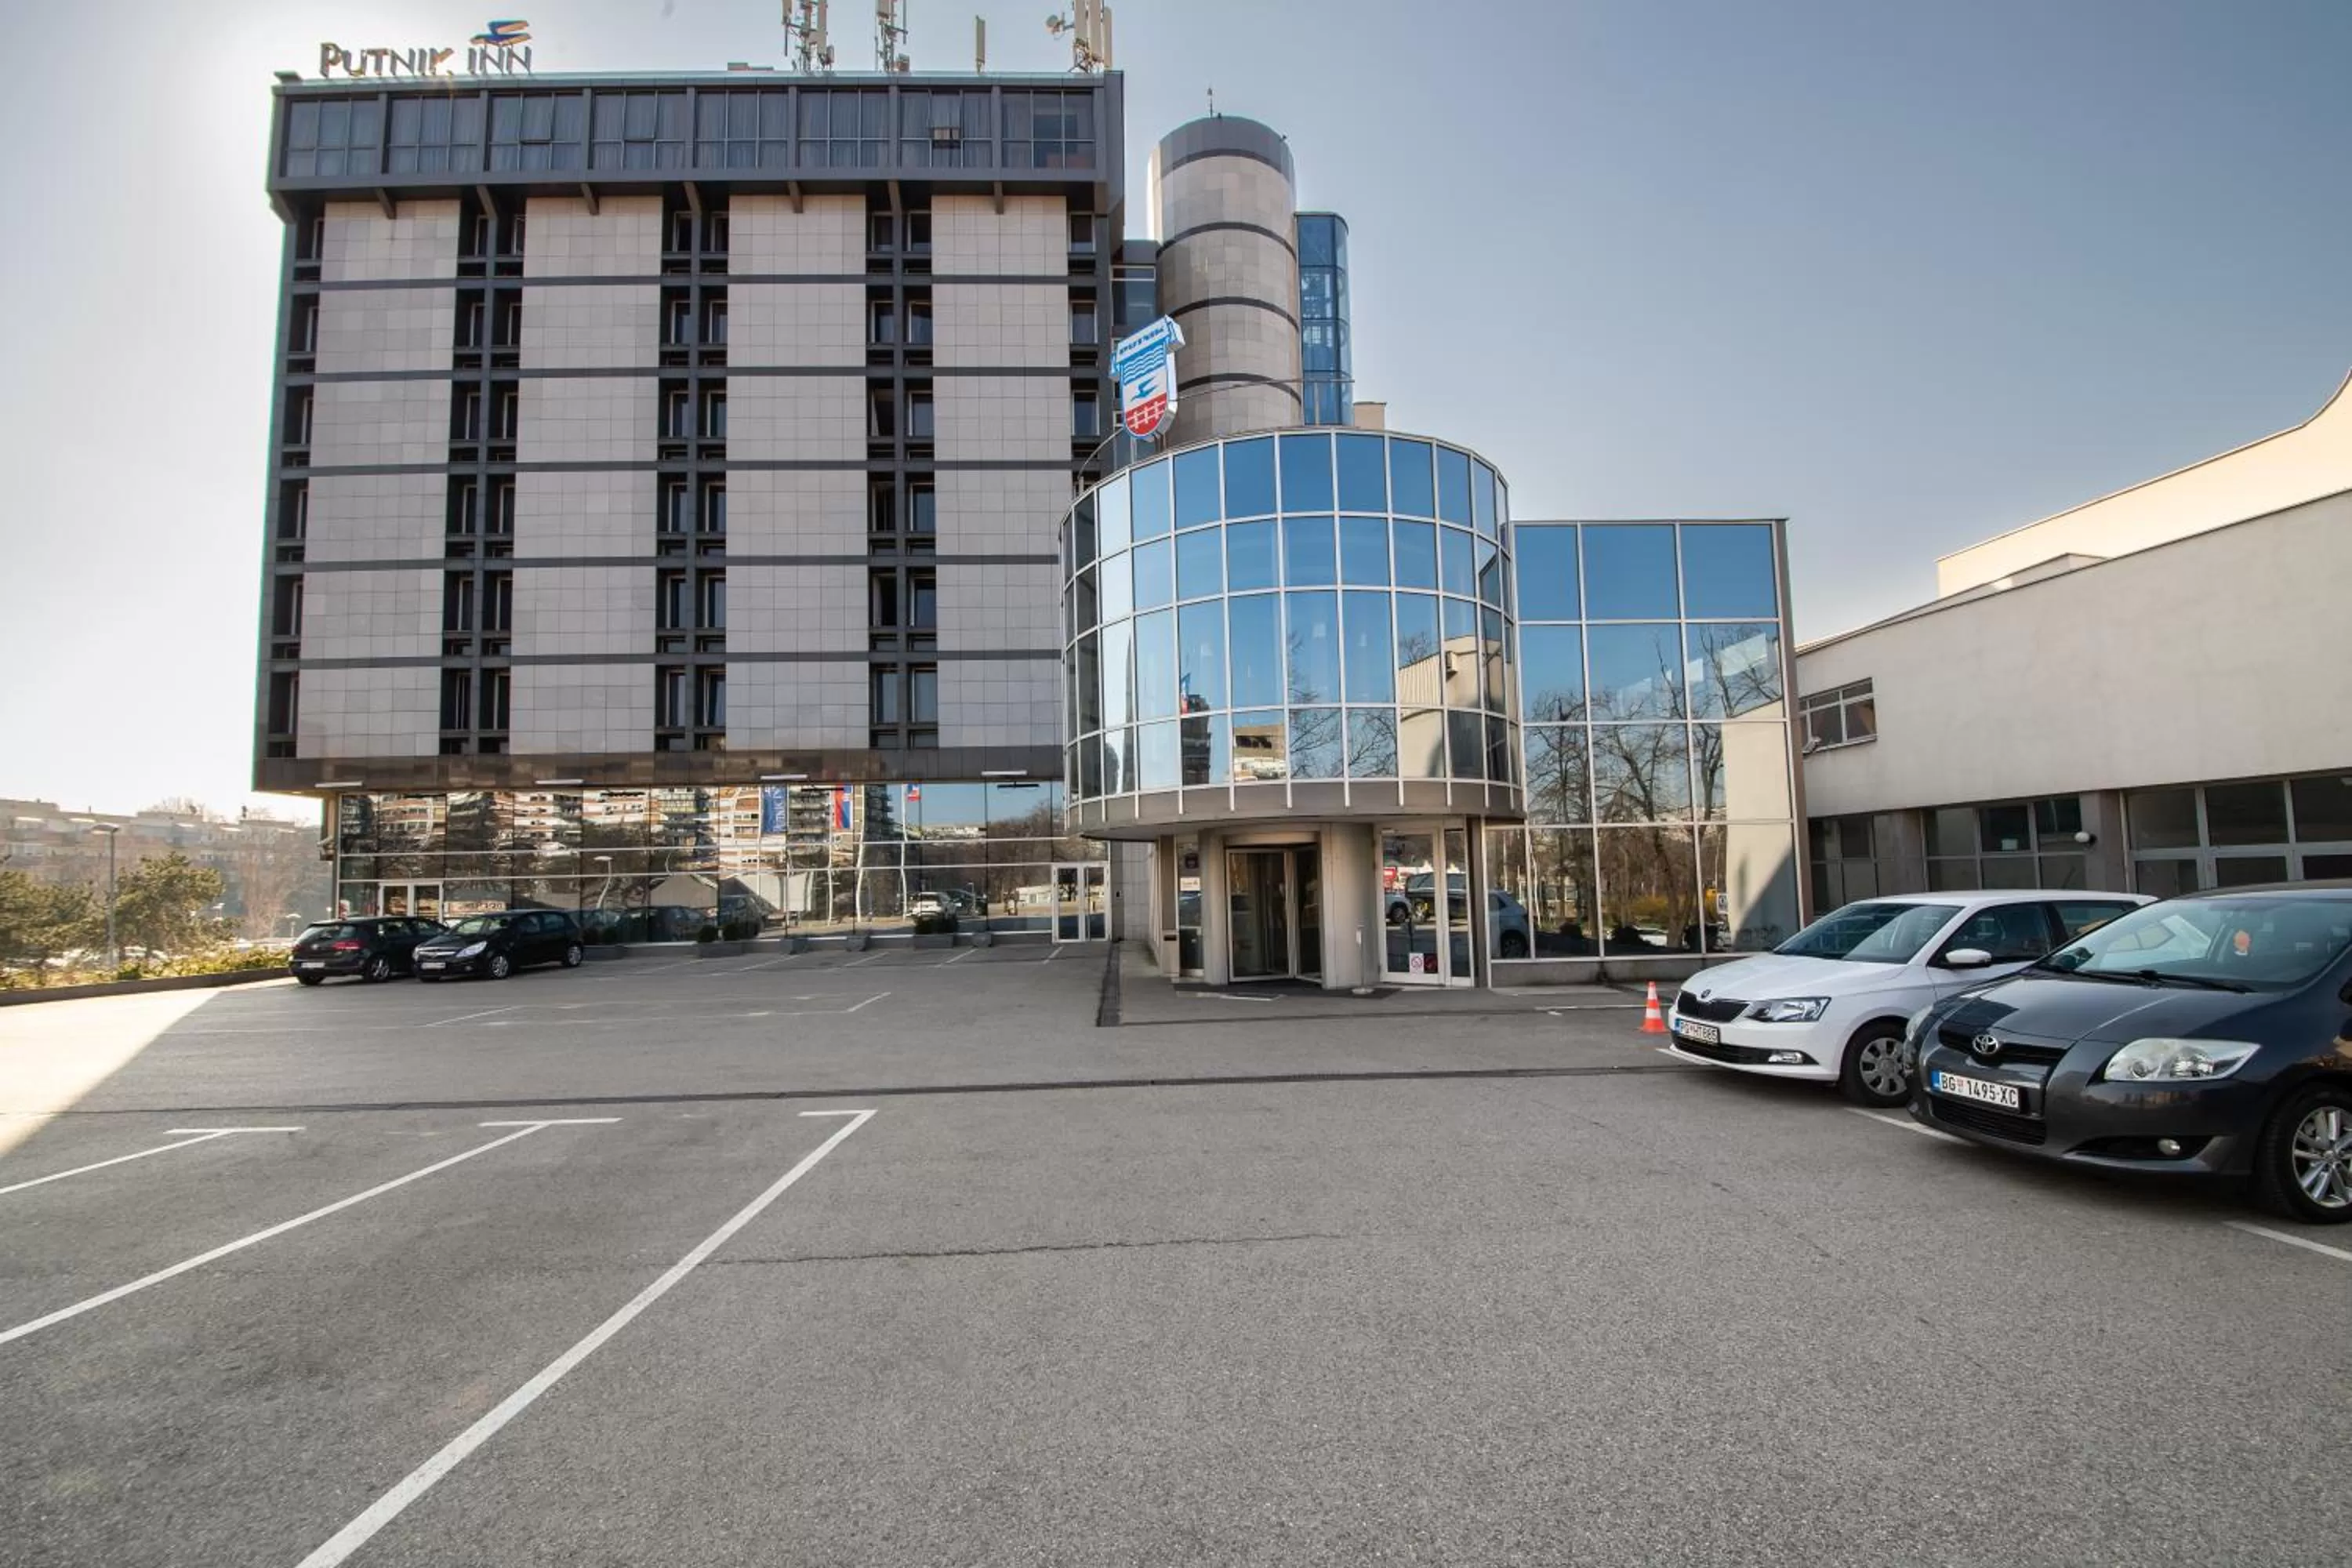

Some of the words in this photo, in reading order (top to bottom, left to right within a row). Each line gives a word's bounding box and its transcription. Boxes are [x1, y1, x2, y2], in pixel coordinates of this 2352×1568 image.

[320, 42, 454, 78] PUTNIK
[468, 45, 532, 77] INN
[1940, 1073, 1956, 1091] BG
[1967, 1080, 2017, 1105] 1495-XC
